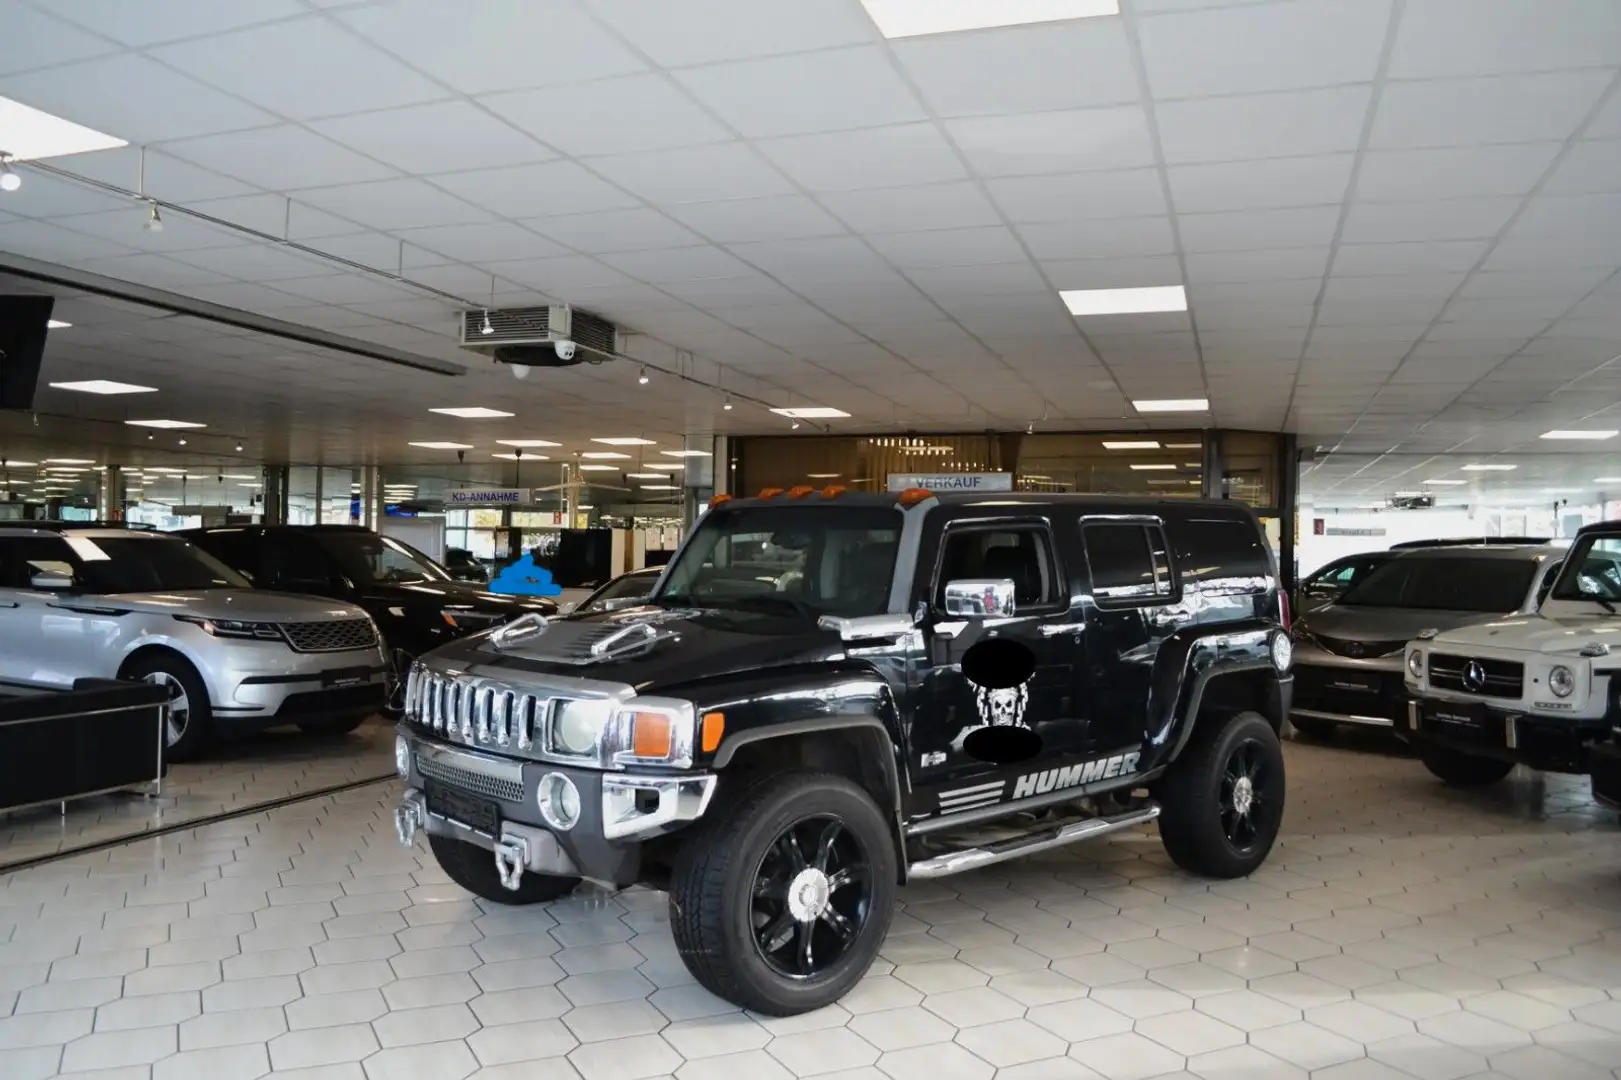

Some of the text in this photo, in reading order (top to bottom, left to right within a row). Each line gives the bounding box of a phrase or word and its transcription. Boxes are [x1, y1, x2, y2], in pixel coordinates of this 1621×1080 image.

[917, 477, 982, 488] VERKAUF
[452, 492, 520, 501] KD-ANNAHME
[1012, 751, 1141, 799] HUMMER
